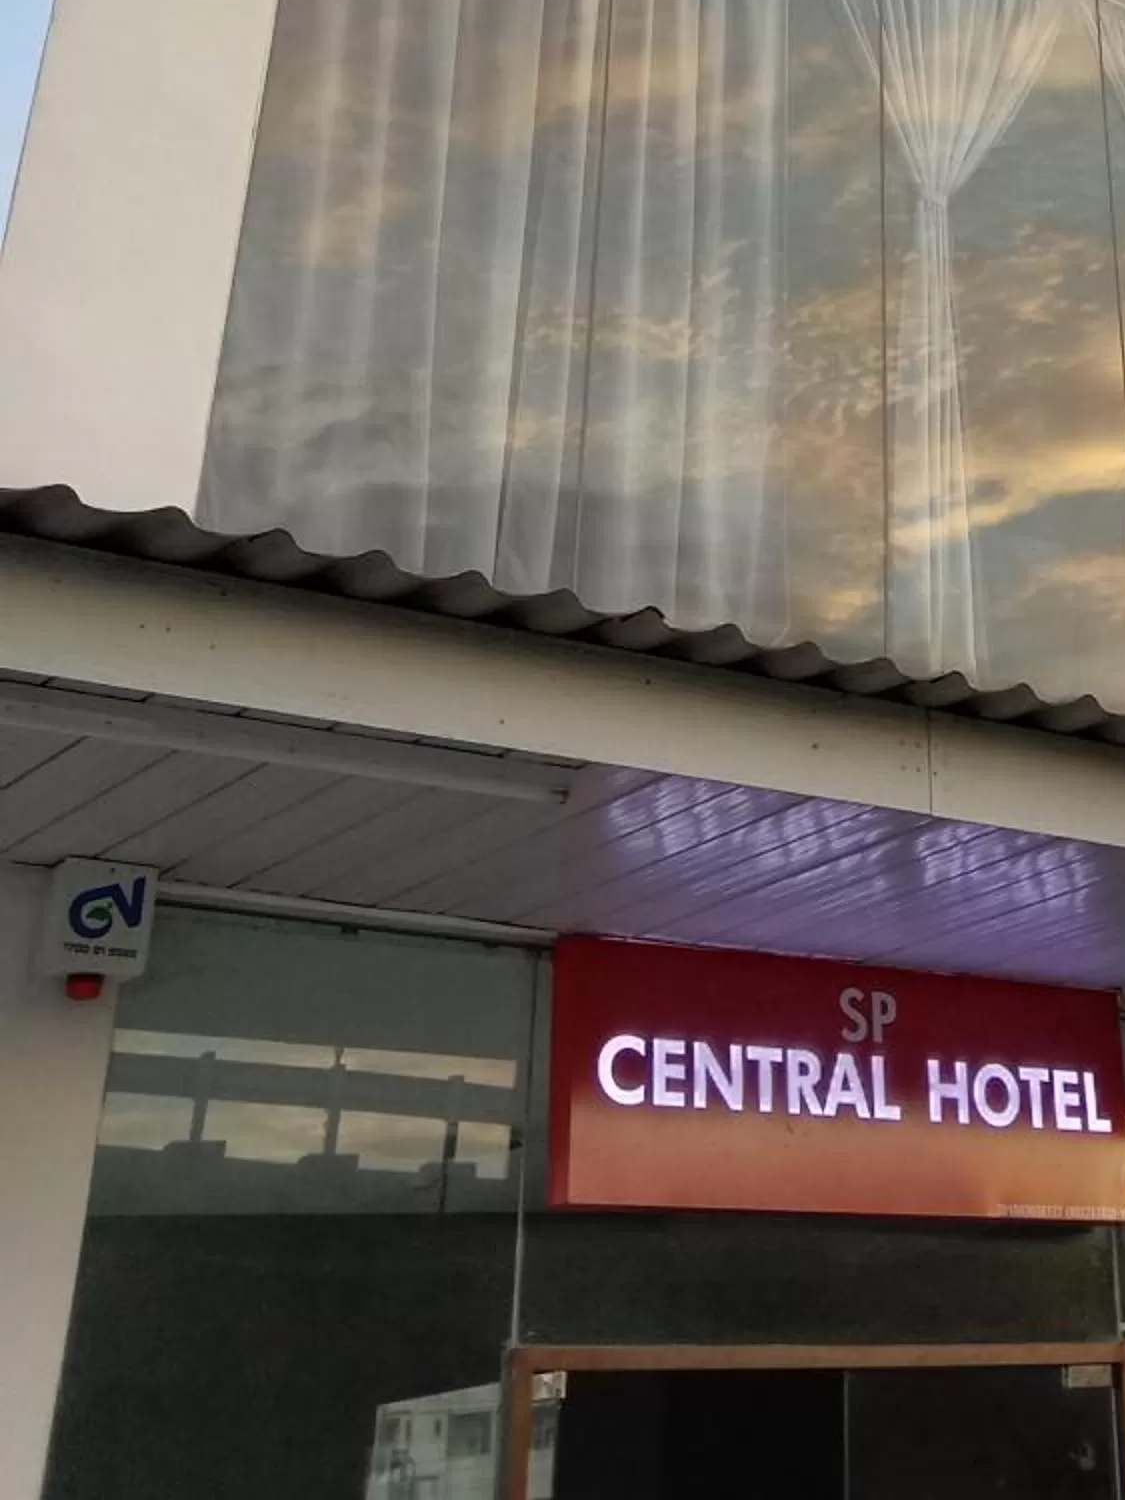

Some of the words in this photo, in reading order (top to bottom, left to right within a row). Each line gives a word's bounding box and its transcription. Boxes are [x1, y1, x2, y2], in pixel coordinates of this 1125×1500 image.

[838, 987, 898, 1044] SP
[597, 1034, 902, 1121] CENTRAL
[927, 1059, 1113, 1133] HOTEL
